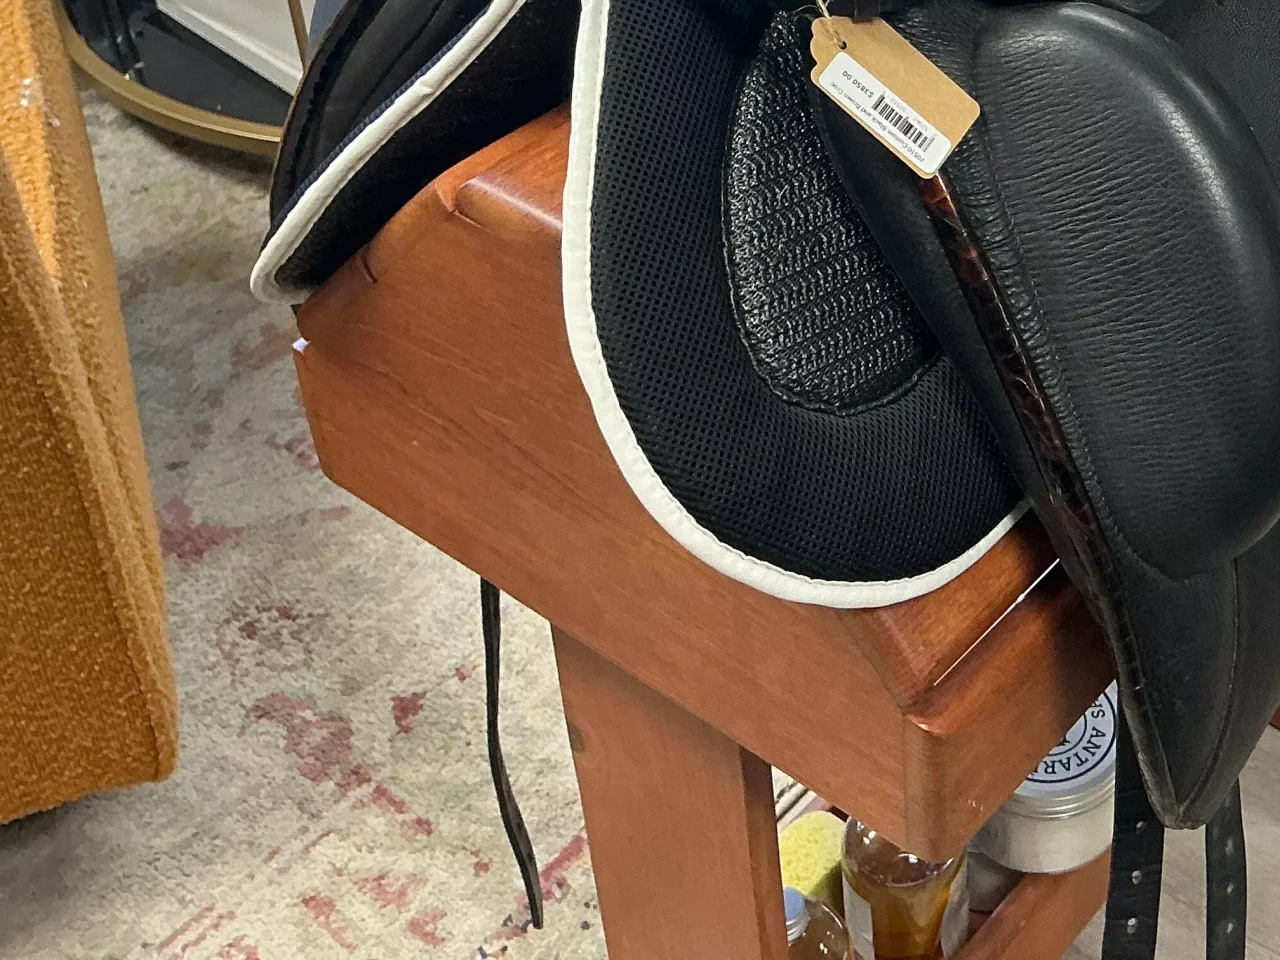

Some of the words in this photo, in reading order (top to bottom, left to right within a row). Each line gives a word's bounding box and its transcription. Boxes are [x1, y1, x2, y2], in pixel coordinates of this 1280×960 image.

[830, 82, 844, 95] Croc
[843, 94, 861, 109] Brown
[860, 107, 873, 119] and
[871, 116, 887, 131] Black
[887, 130, 908, 149] Custom
